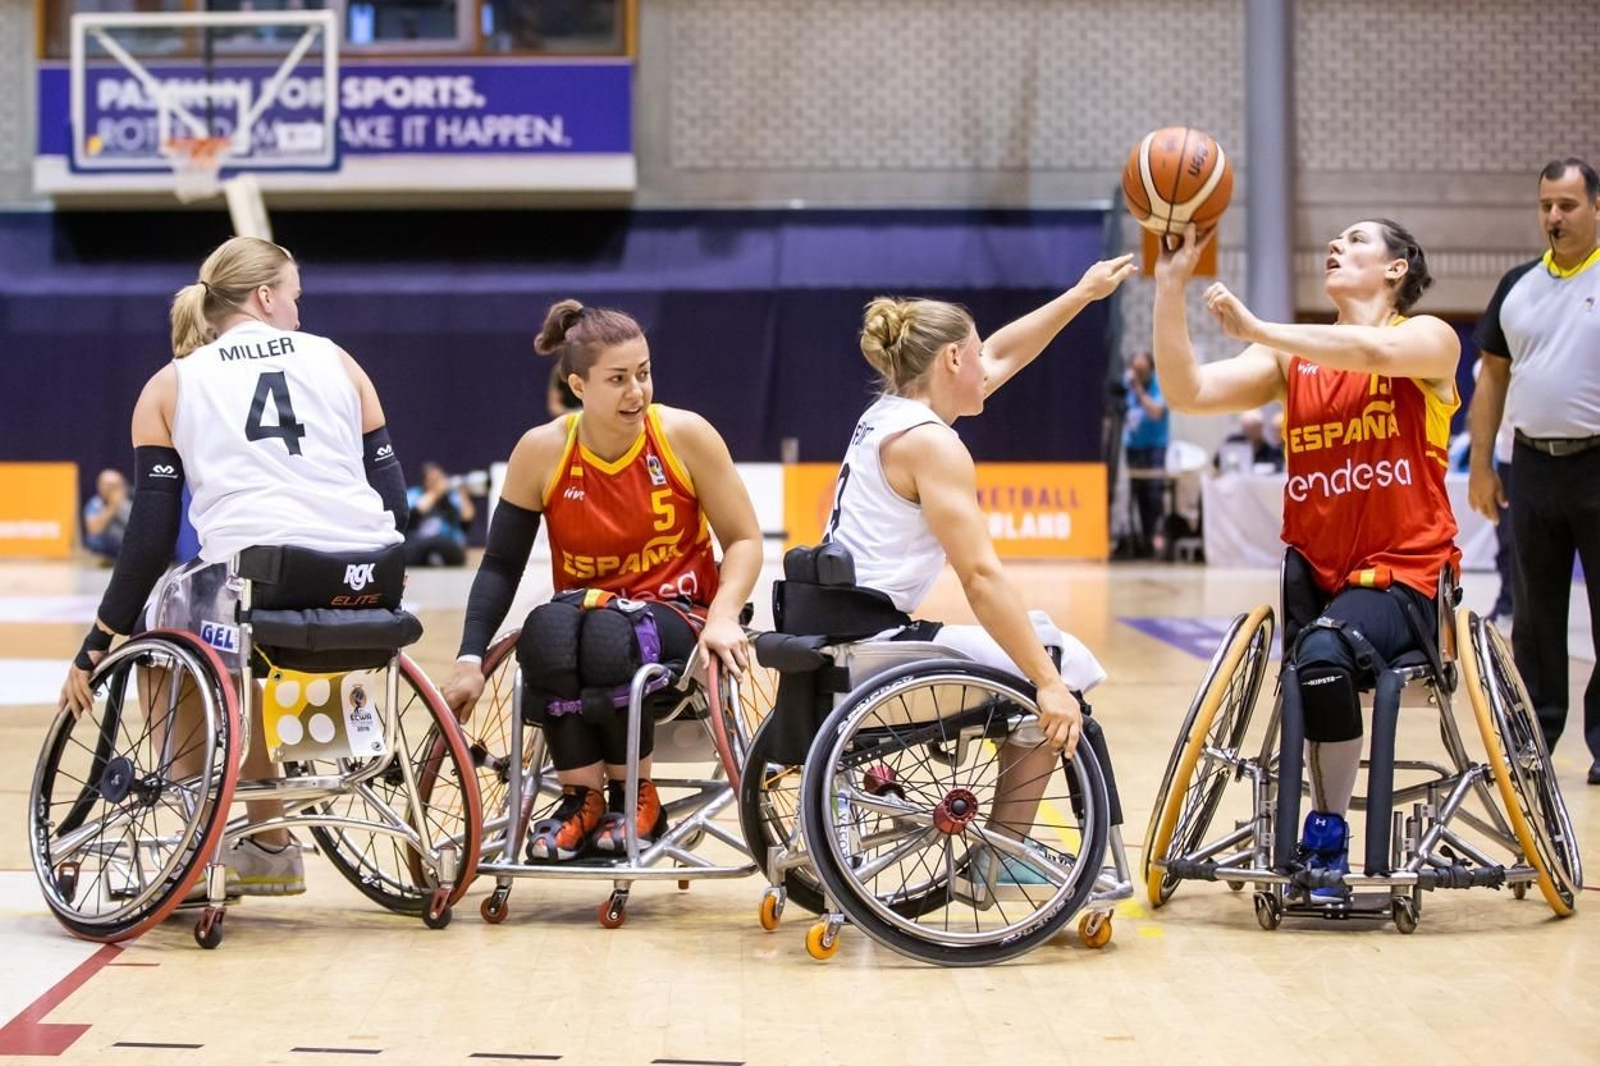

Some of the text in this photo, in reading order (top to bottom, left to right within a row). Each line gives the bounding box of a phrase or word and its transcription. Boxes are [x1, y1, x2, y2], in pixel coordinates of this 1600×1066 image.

[341, 75, 486, 108] SPORTS.
[339, 115, 394, 147] AKE
[403, 115, 429, 146] IT
[435, 114, 573, 147] HAPPEN.
[219, 337, 295, 361] MILLER
[245, 371, 305, 457] 4
[1290, 400, 1400, 453] ESPAÑA
[1288, 458, 1412, 502] endesa
[651, 489, 675, 531] 5
[563, 529, 685, 579] ESPAÑA
[331, 593, 382, 606] ELITE
[202, 624, 234, 649] GEL
